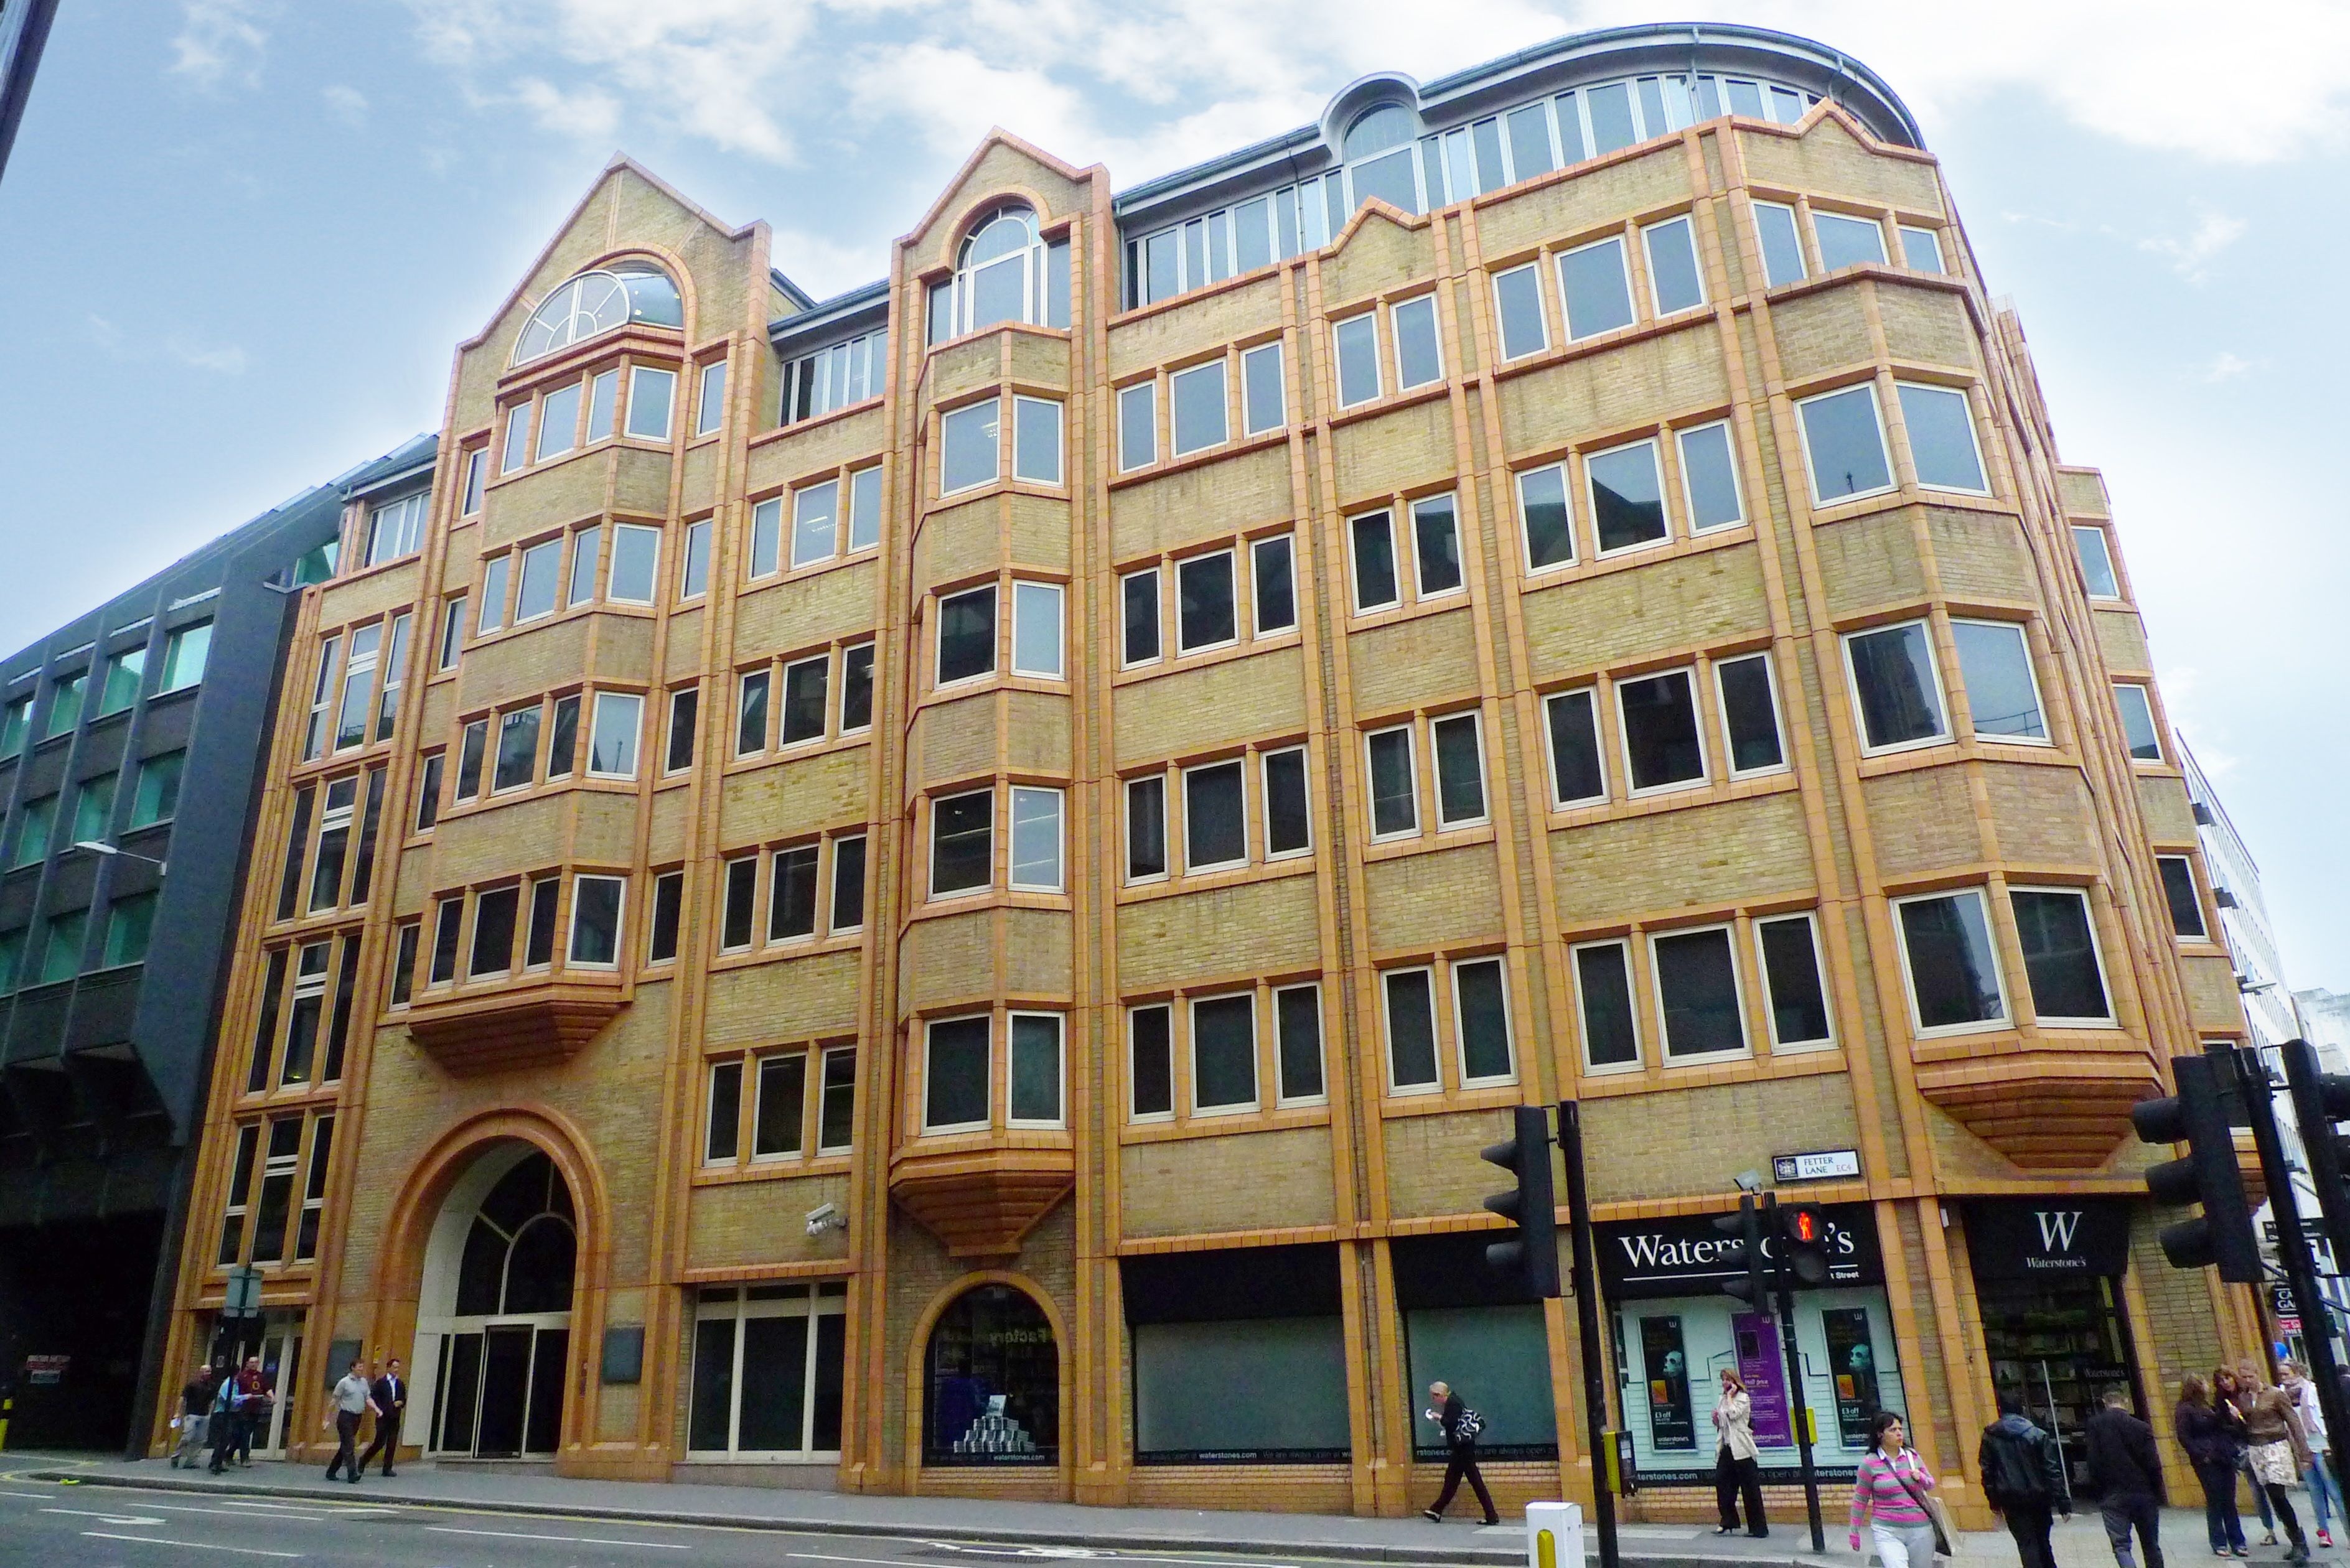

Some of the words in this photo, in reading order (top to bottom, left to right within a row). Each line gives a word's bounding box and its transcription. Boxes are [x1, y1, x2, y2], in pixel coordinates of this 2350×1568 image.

[1804, 1157, 1834, 1166] FETTER
[1805, 1166, 1828, 1175] LANE
[1836, 1164, 1852, 1172] EC4
[2034, 1211, 2084, 1252] W
[1618, 1221, 1855, 1268] Waterso's
[2026, 1256, 2086, 1268] Waterstone's
[1637, 1472, 1698, 1481] terstones.com
